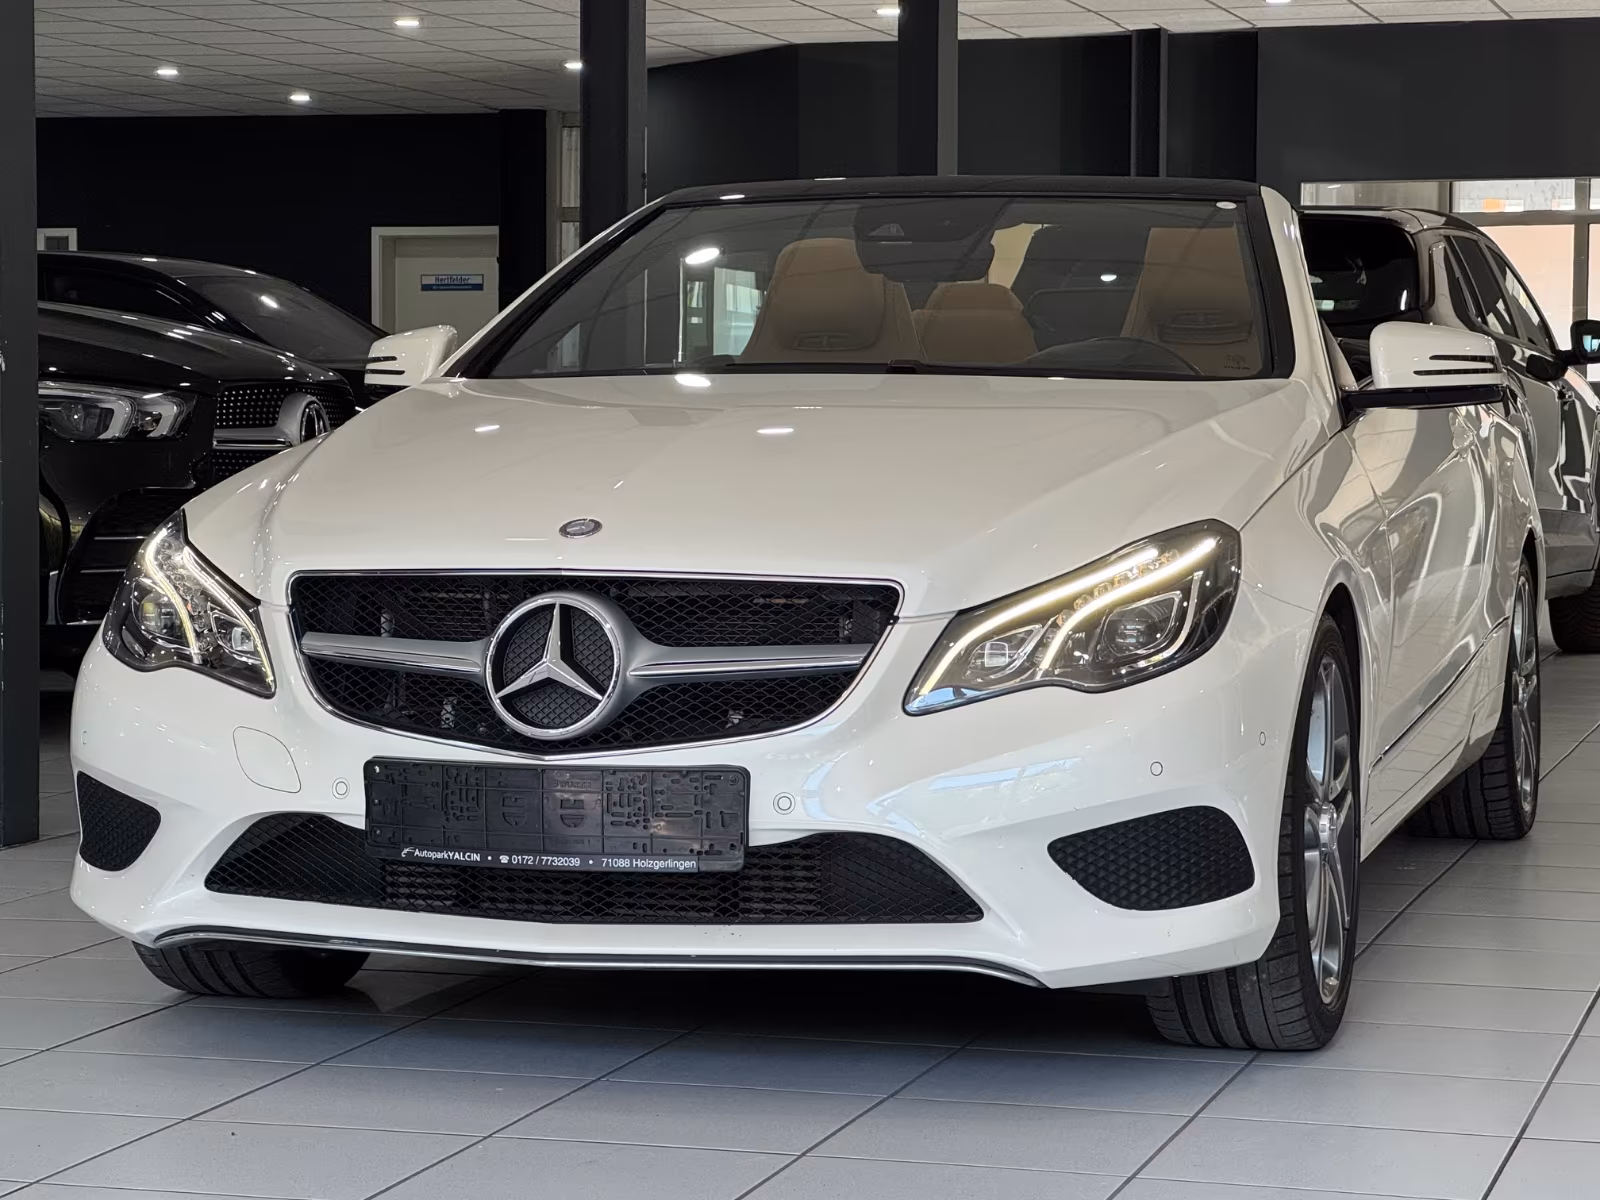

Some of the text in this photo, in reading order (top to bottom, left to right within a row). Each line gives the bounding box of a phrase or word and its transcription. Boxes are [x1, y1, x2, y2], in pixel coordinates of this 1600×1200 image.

[434, 275, 471, 284] Hertfelder
[511, 855, 534, 865] 0172
[540, 856, 581, 867] 7732039
[601, 858, 631, 868] 71088
[632, 857, 697, 871] Holzgerlingen
